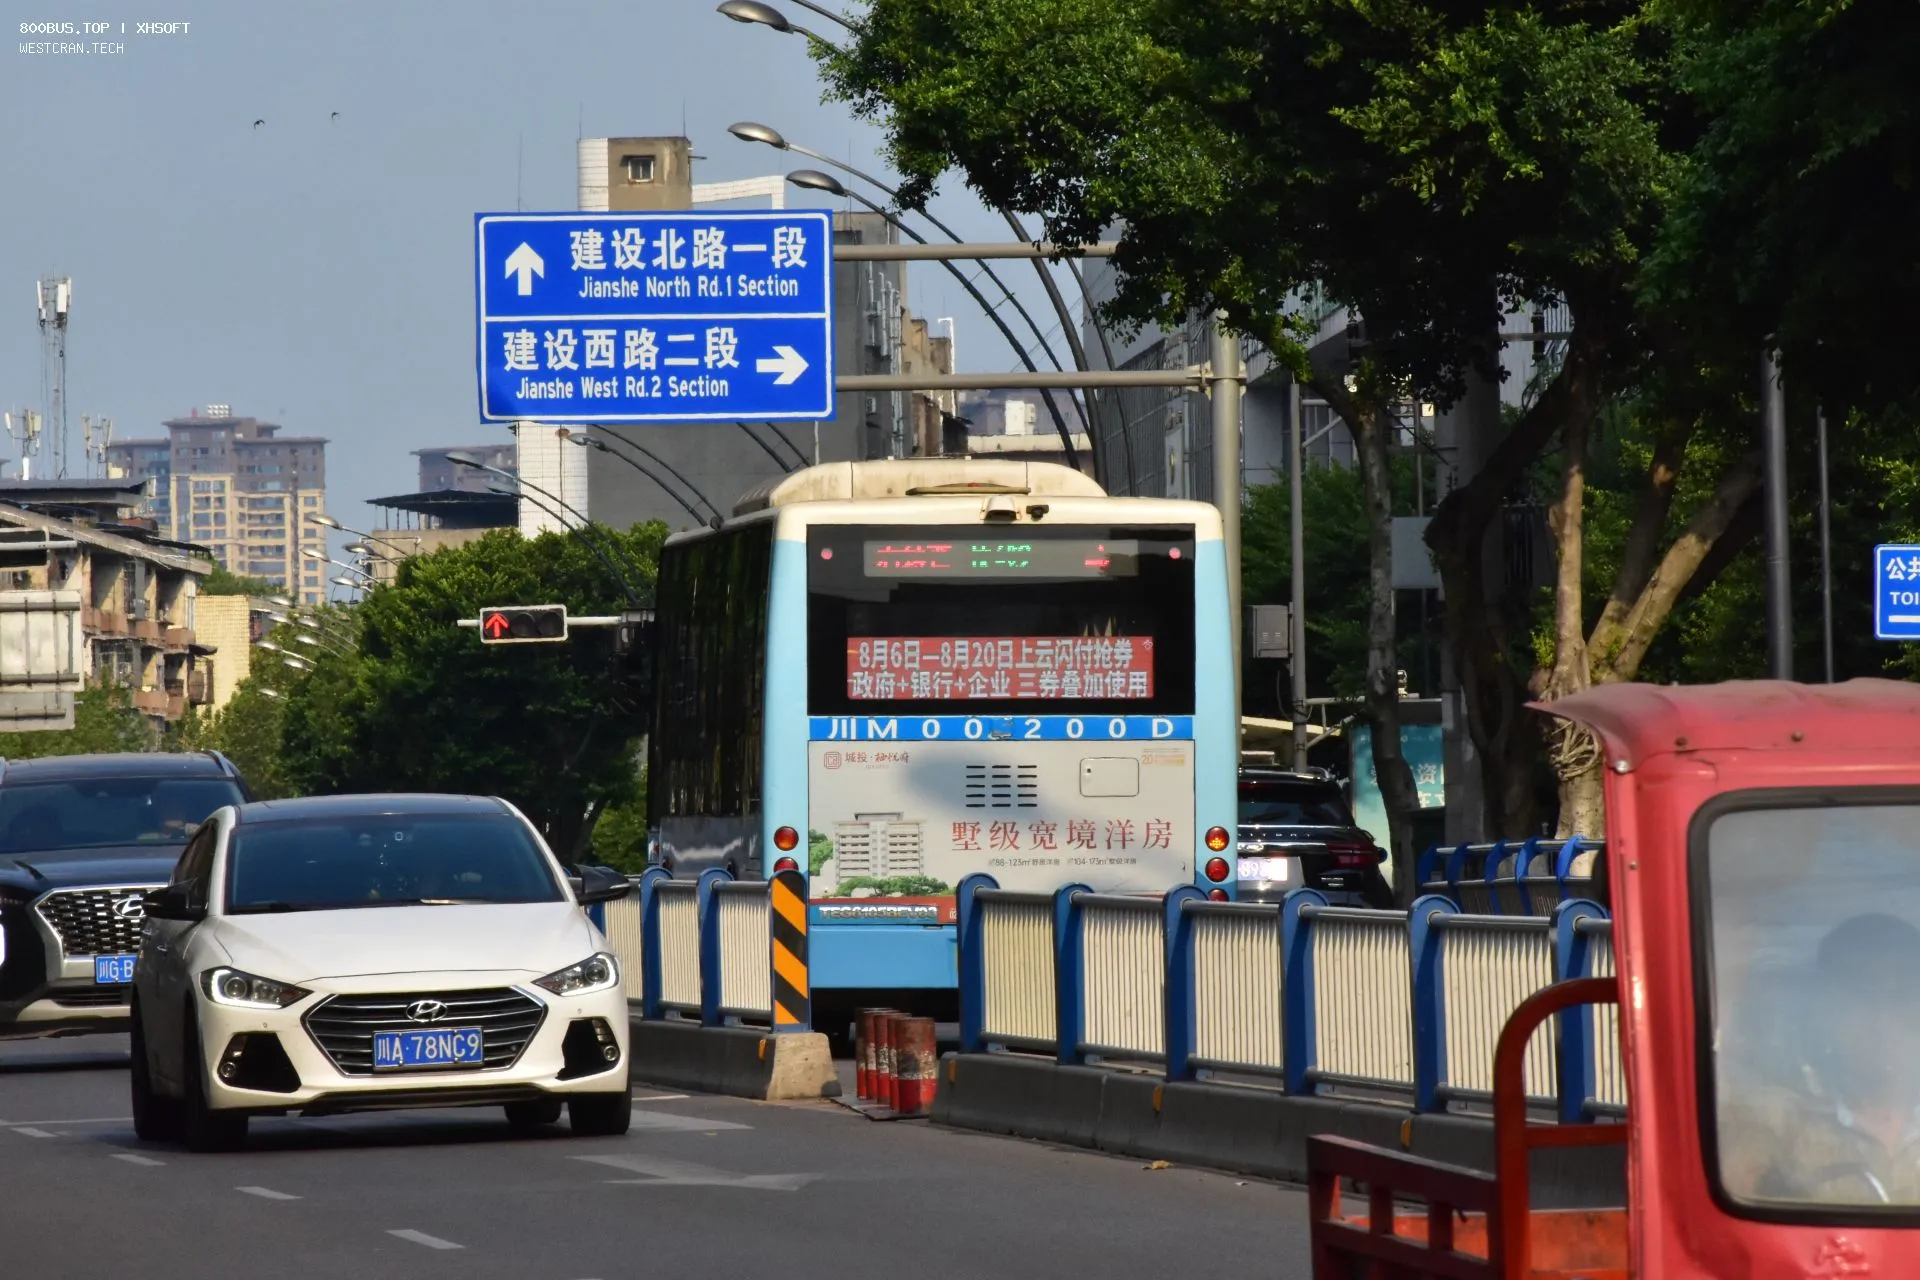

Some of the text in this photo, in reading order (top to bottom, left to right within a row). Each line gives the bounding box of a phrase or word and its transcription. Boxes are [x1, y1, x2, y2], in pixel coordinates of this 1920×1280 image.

[569, 226, 808, 271] 建设北路一段
[579, 277, 639, 299] Jianshe
[646, 276, 691, 298] North
[738, 274, 799, 297] Section
[503, 326, 740, 372] 建设西路二段
[516, 378, 573, 399] Jianshe
[581, 377, 619, 399] West
[669, 375, 729, 397] Section
[951, 818, 1174, 851] 墅级宽境洋房
